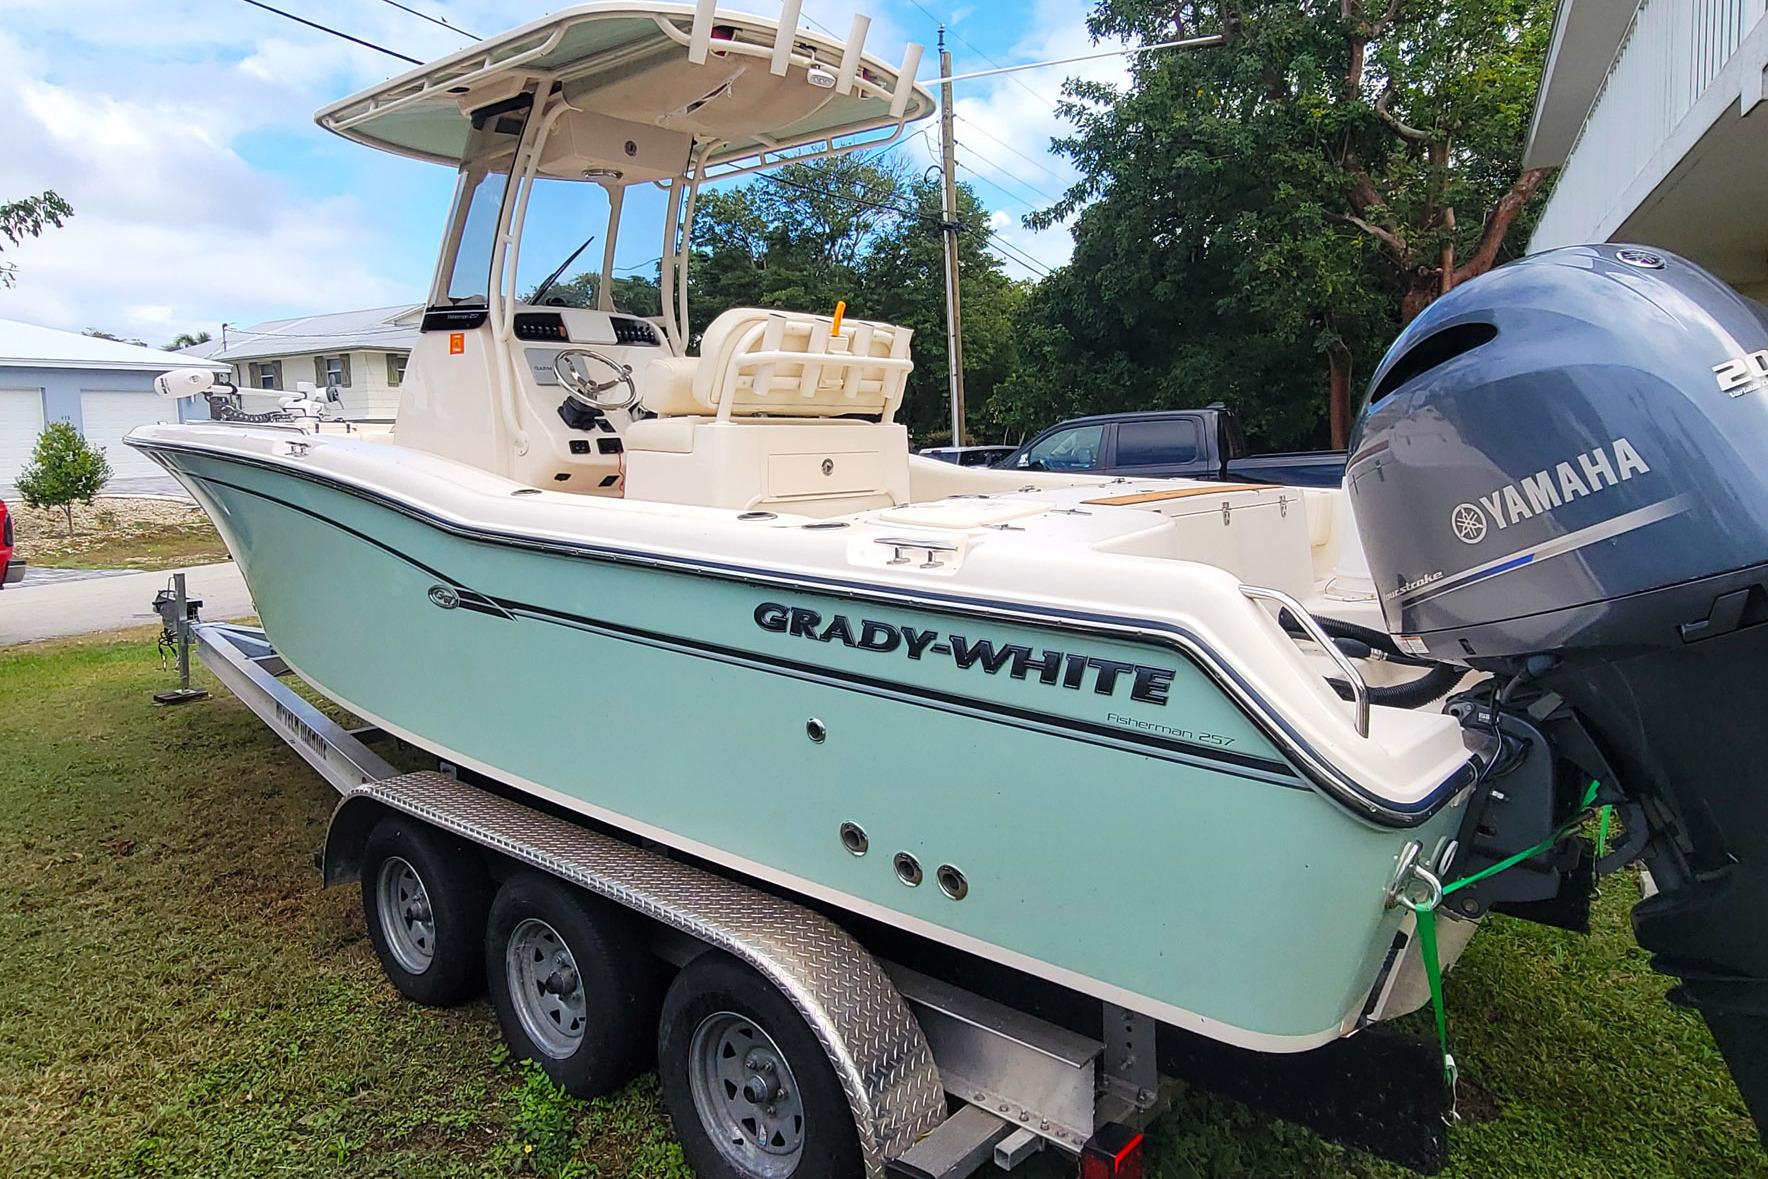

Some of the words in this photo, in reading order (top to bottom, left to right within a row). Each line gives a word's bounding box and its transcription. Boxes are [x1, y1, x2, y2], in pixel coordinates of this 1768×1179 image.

[1479, 437, 1650, 531] YAMAHA
[753, 601, 1177, 706] GRADY-WHITE
[1106, 711, 1193, 741] Fisherman
[1198, 731, 1236, 747] 257
